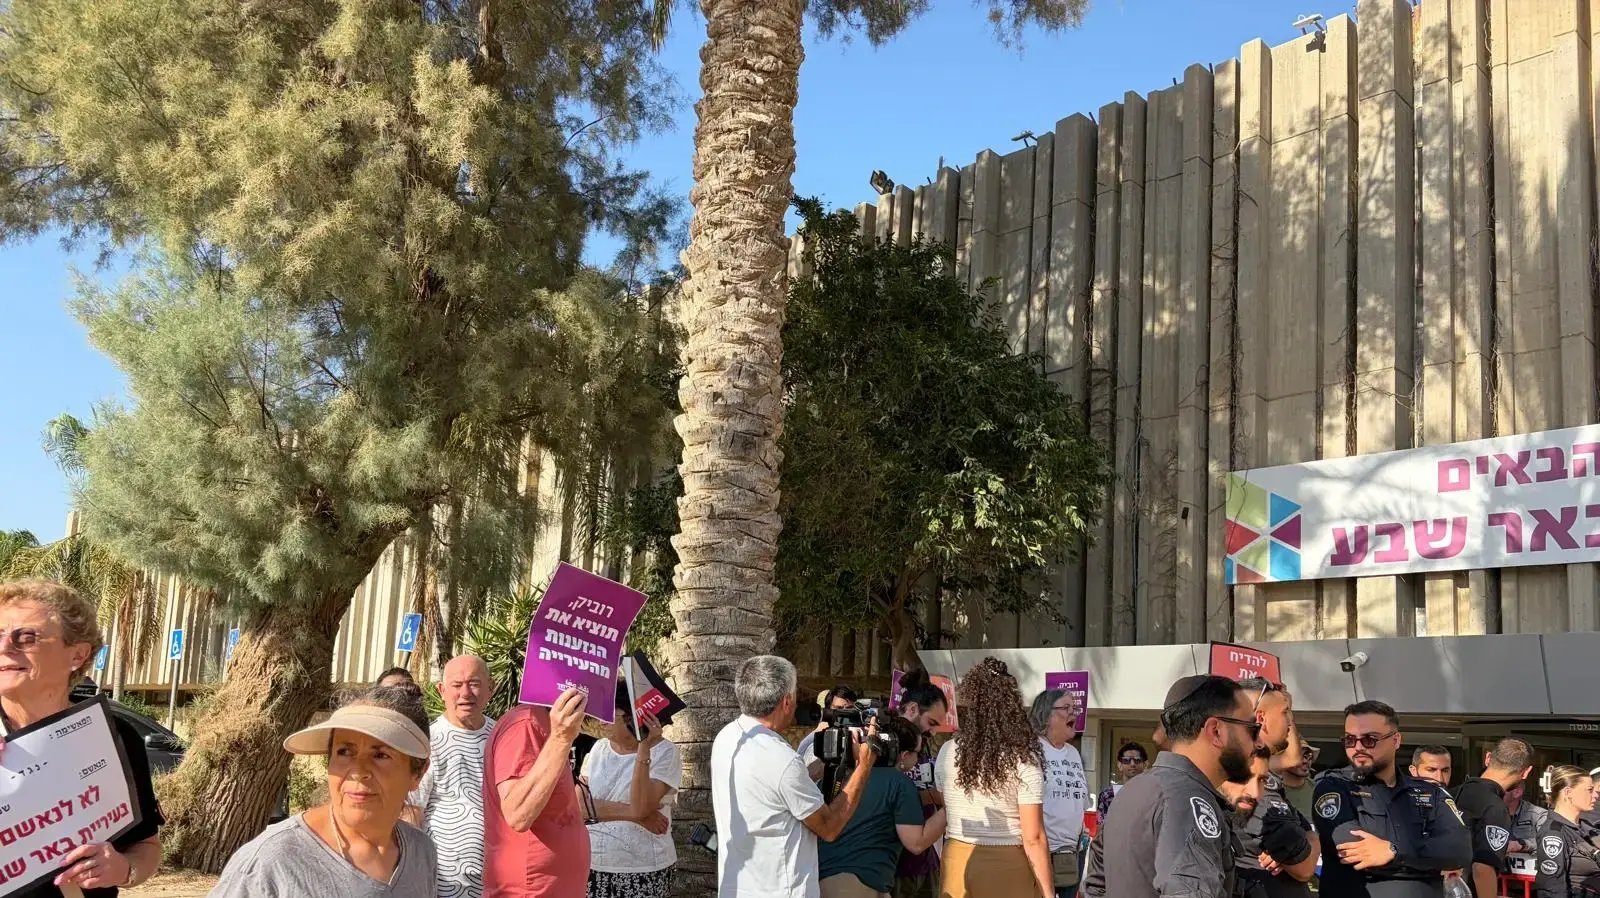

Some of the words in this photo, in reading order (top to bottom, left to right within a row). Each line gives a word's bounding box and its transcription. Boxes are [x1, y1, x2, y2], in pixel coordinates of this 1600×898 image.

[1330, 516, 1468, 566] שבע
[544, 607, 573, 625] את
[567, 595, 614, 618] רוביק,
[571, 615, 619, 642] תוציא
[544, 628, 608, 659] הגזענות
[538, 646, 611, 679] מהעירייה
[1230, 651, 1267, 668] להדיח
[1238, 668, 1258, 679] את
[77, 784, 99, 809] לא
[30, 837, 77, 864] באר
